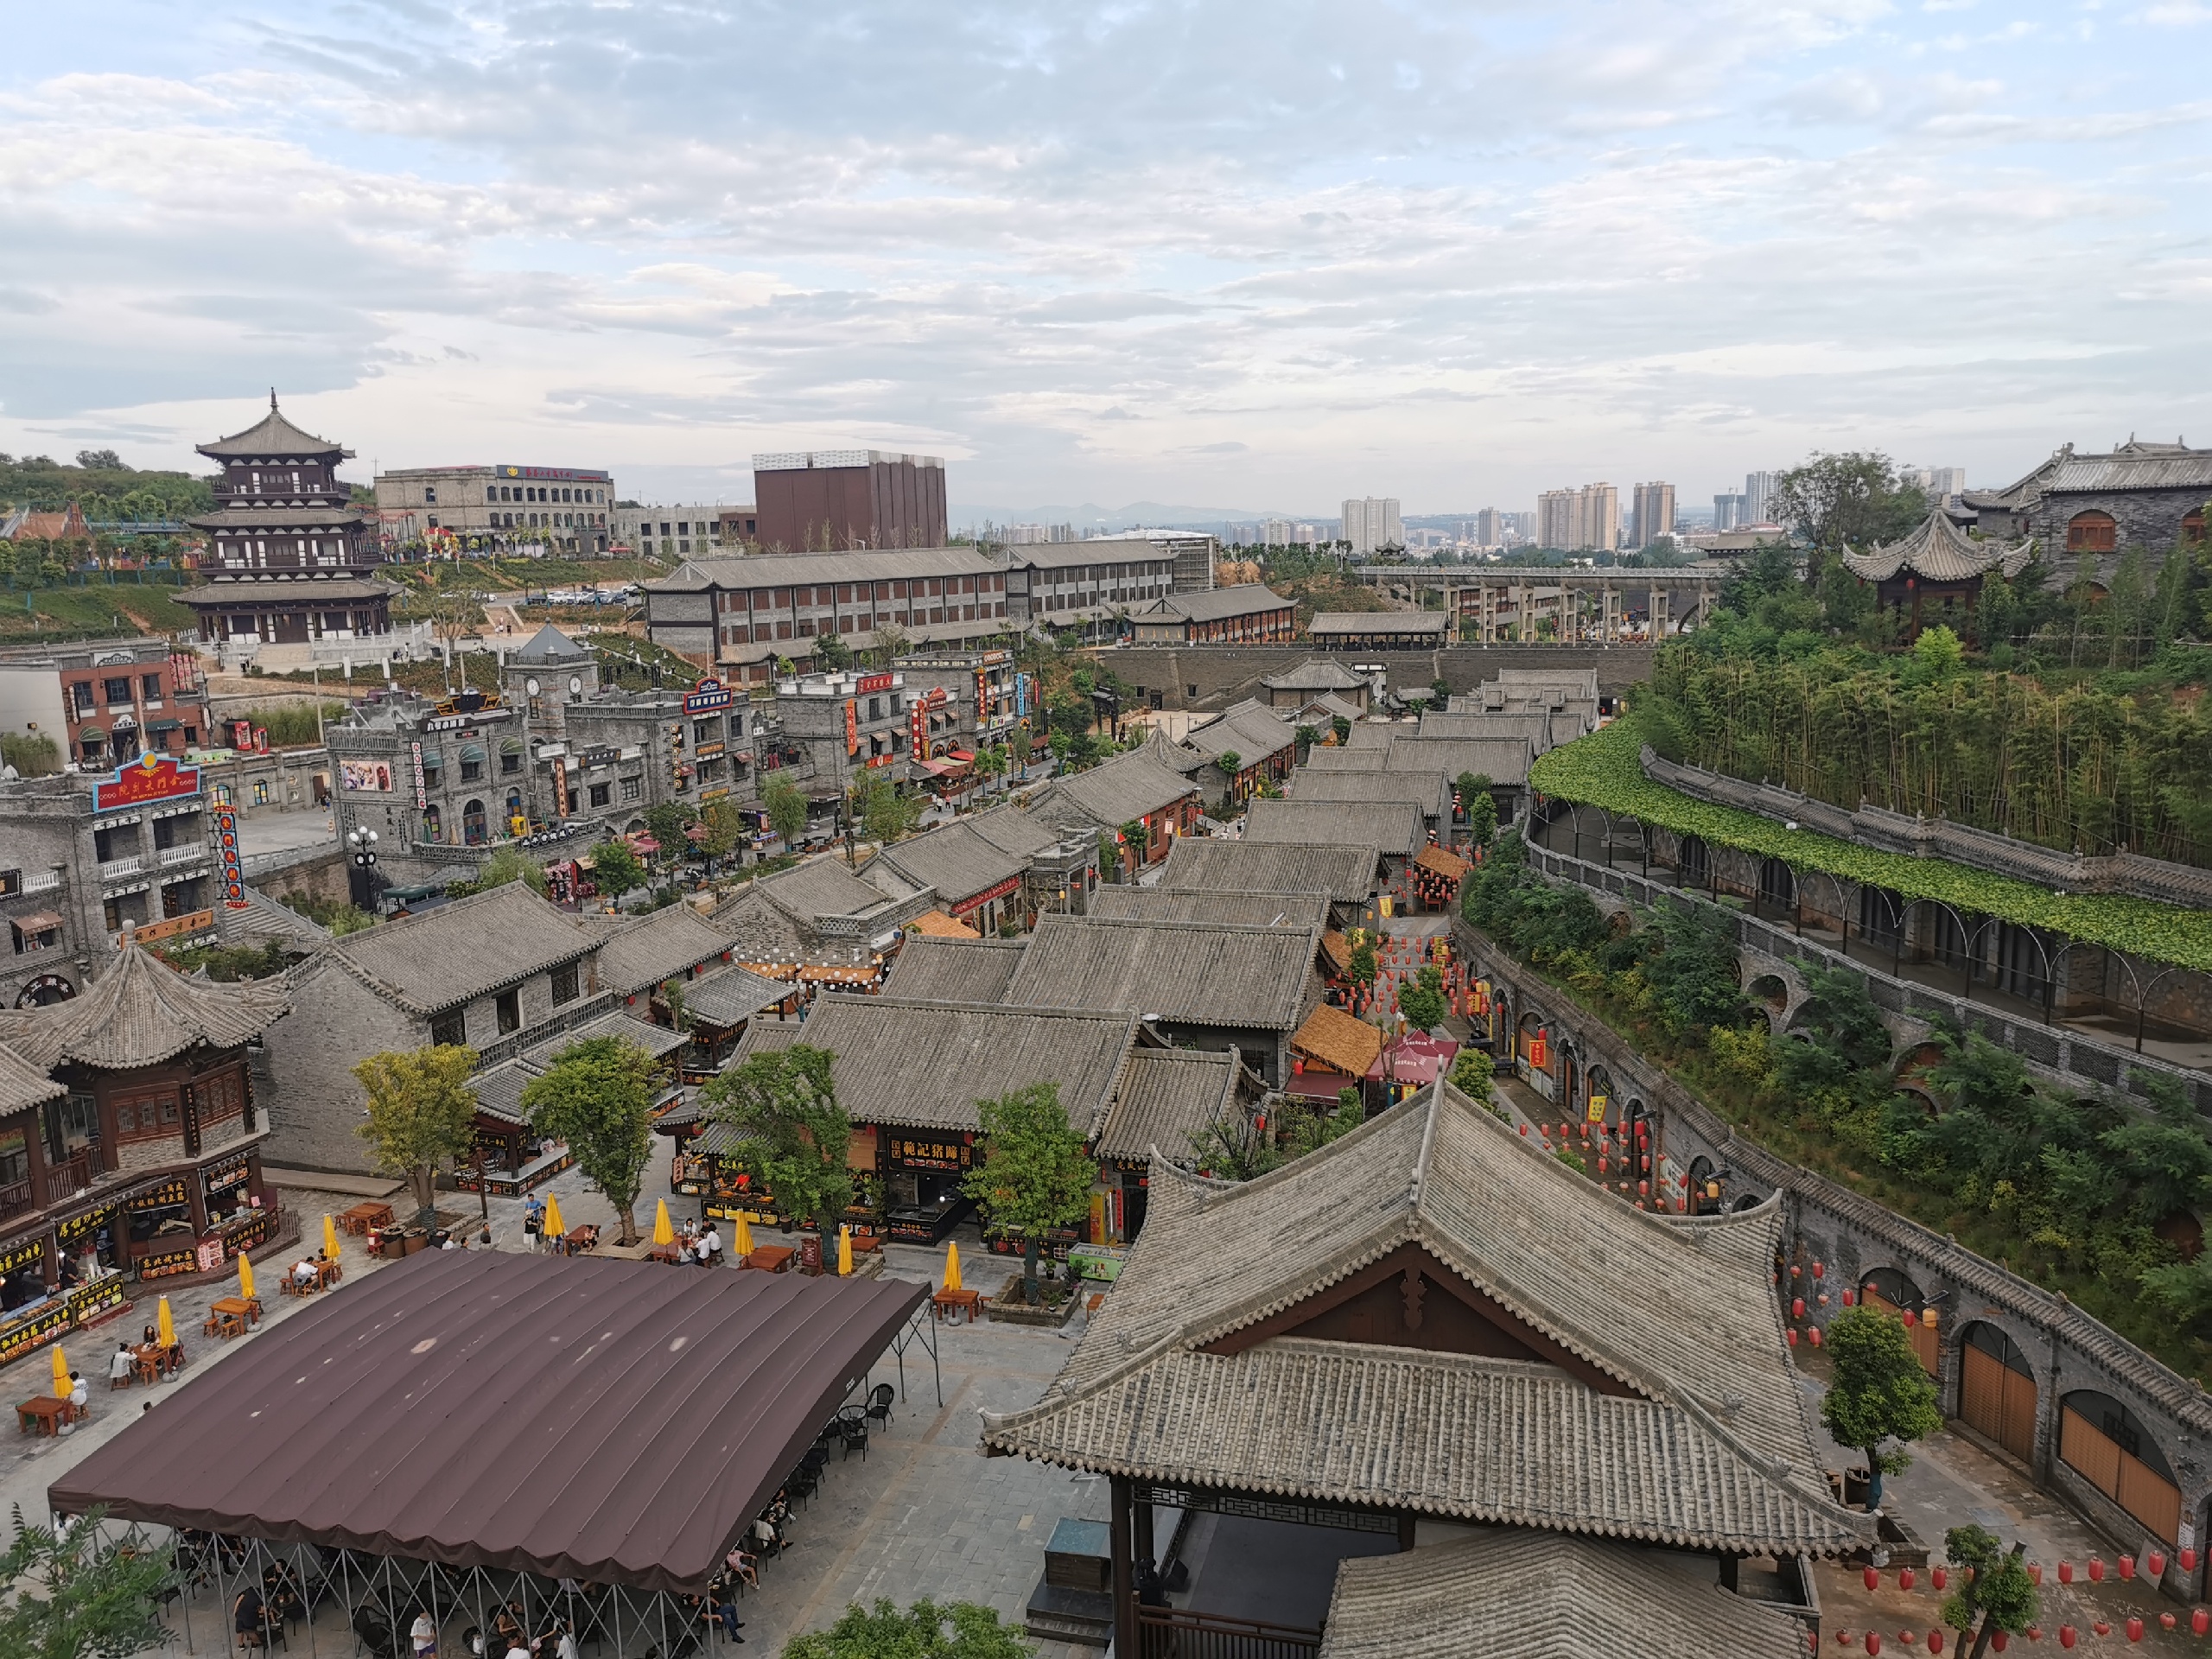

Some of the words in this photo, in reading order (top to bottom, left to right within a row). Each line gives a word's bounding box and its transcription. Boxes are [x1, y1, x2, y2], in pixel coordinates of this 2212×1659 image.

[903, 1141, 957, 1160] 範記猪蹄
[143, 1250, 193, 1268] 东北烤冷面
